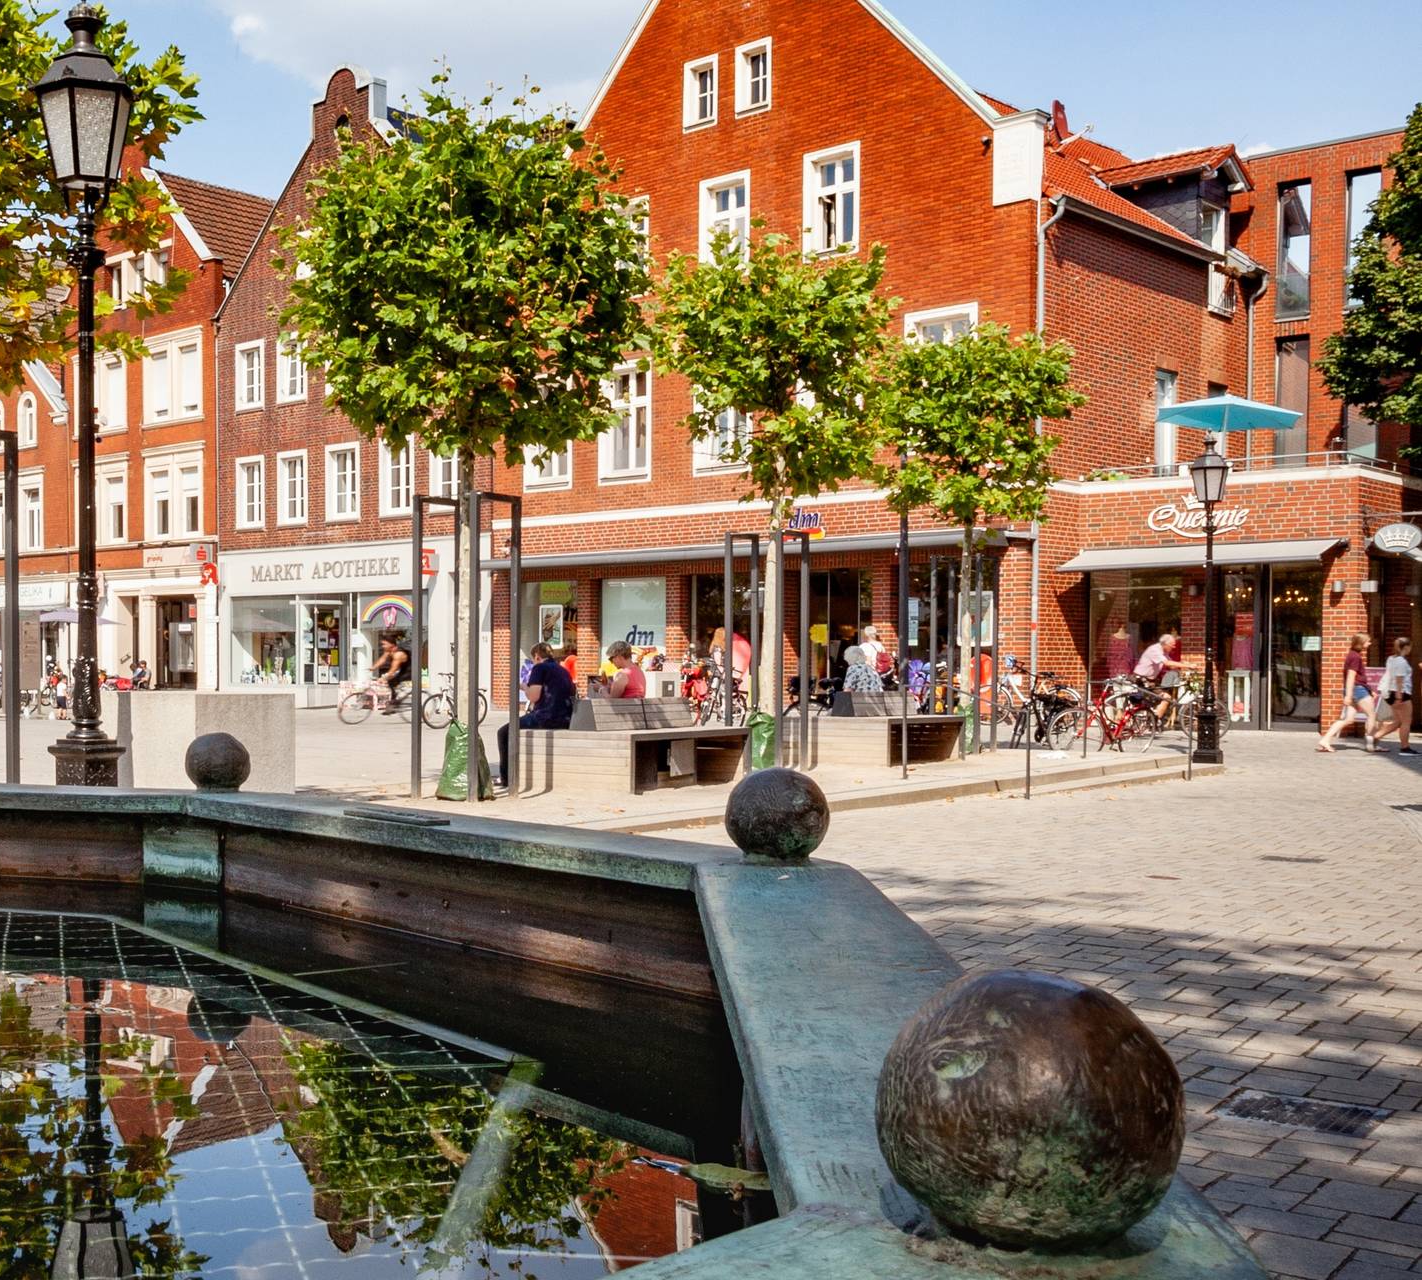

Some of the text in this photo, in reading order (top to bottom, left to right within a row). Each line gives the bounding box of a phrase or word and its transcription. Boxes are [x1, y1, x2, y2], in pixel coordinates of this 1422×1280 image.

[789, 507, 820, 529] dm
[251, 562, 304, 583] MARKT
[311, 556, 401, 580] APOTHEKE
[625, 624, 655, 646] dm
